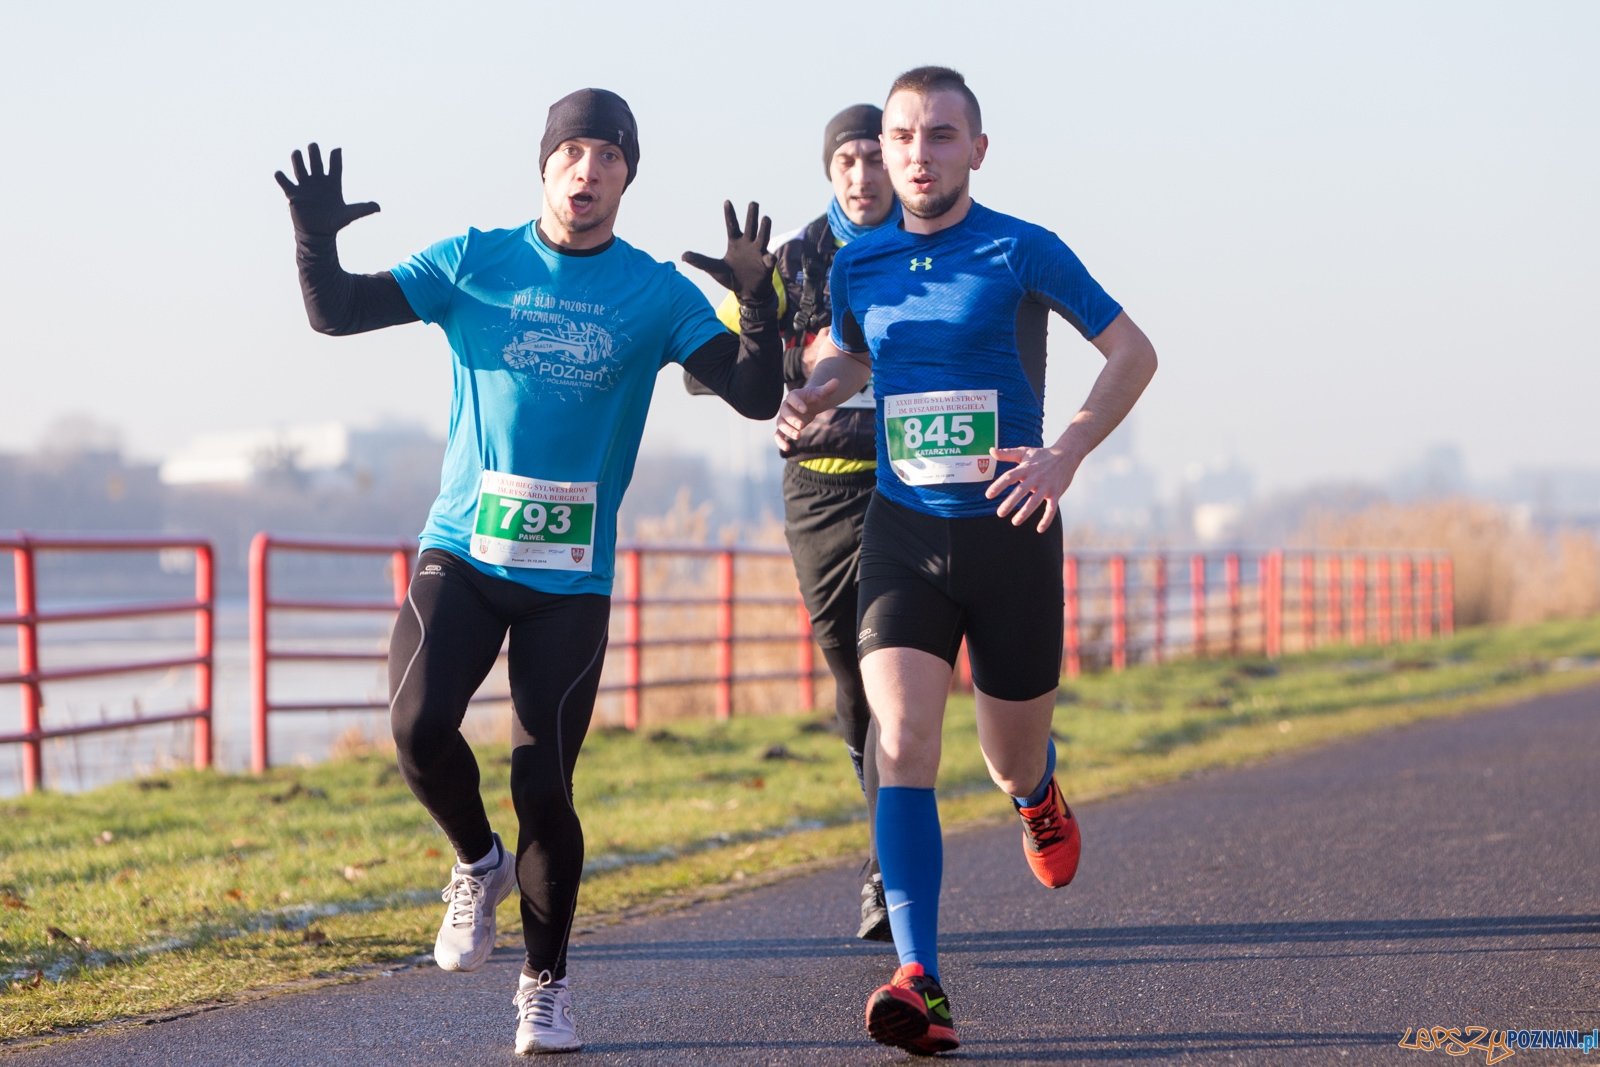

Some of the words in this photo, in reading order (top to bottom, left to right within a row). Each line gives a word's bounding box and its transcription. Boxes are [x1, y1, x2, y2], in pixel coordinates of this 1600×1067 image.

[559, 299, 605, 315] POZOSTAŁ
[510, 308, 519, 320] W
[521, 310, 565, 324] POZNANIU
[895, 398, 913, 406] XXXII
[913, 397, 930, 405] BIEG
[930, 395, 989, 403] SYLWESTROWY
[909, 405, 945, 414] RYSZARDA
[946, 403, 985, 411] BURGIELA
[903, 414, 975, 449] 845
[915, 447, 962, 456] KATARZYNA
[515, 481, 533, 490] BIEG
[534, 484, 589, 493] SYLWESTROWY
[509, 488, 548, 500] RYSZARDA
[549, 494, 586, 502] BURGIELA
[499, 498, 572, 535] 793
[518, 533, 546, 541] PAWEŁ
